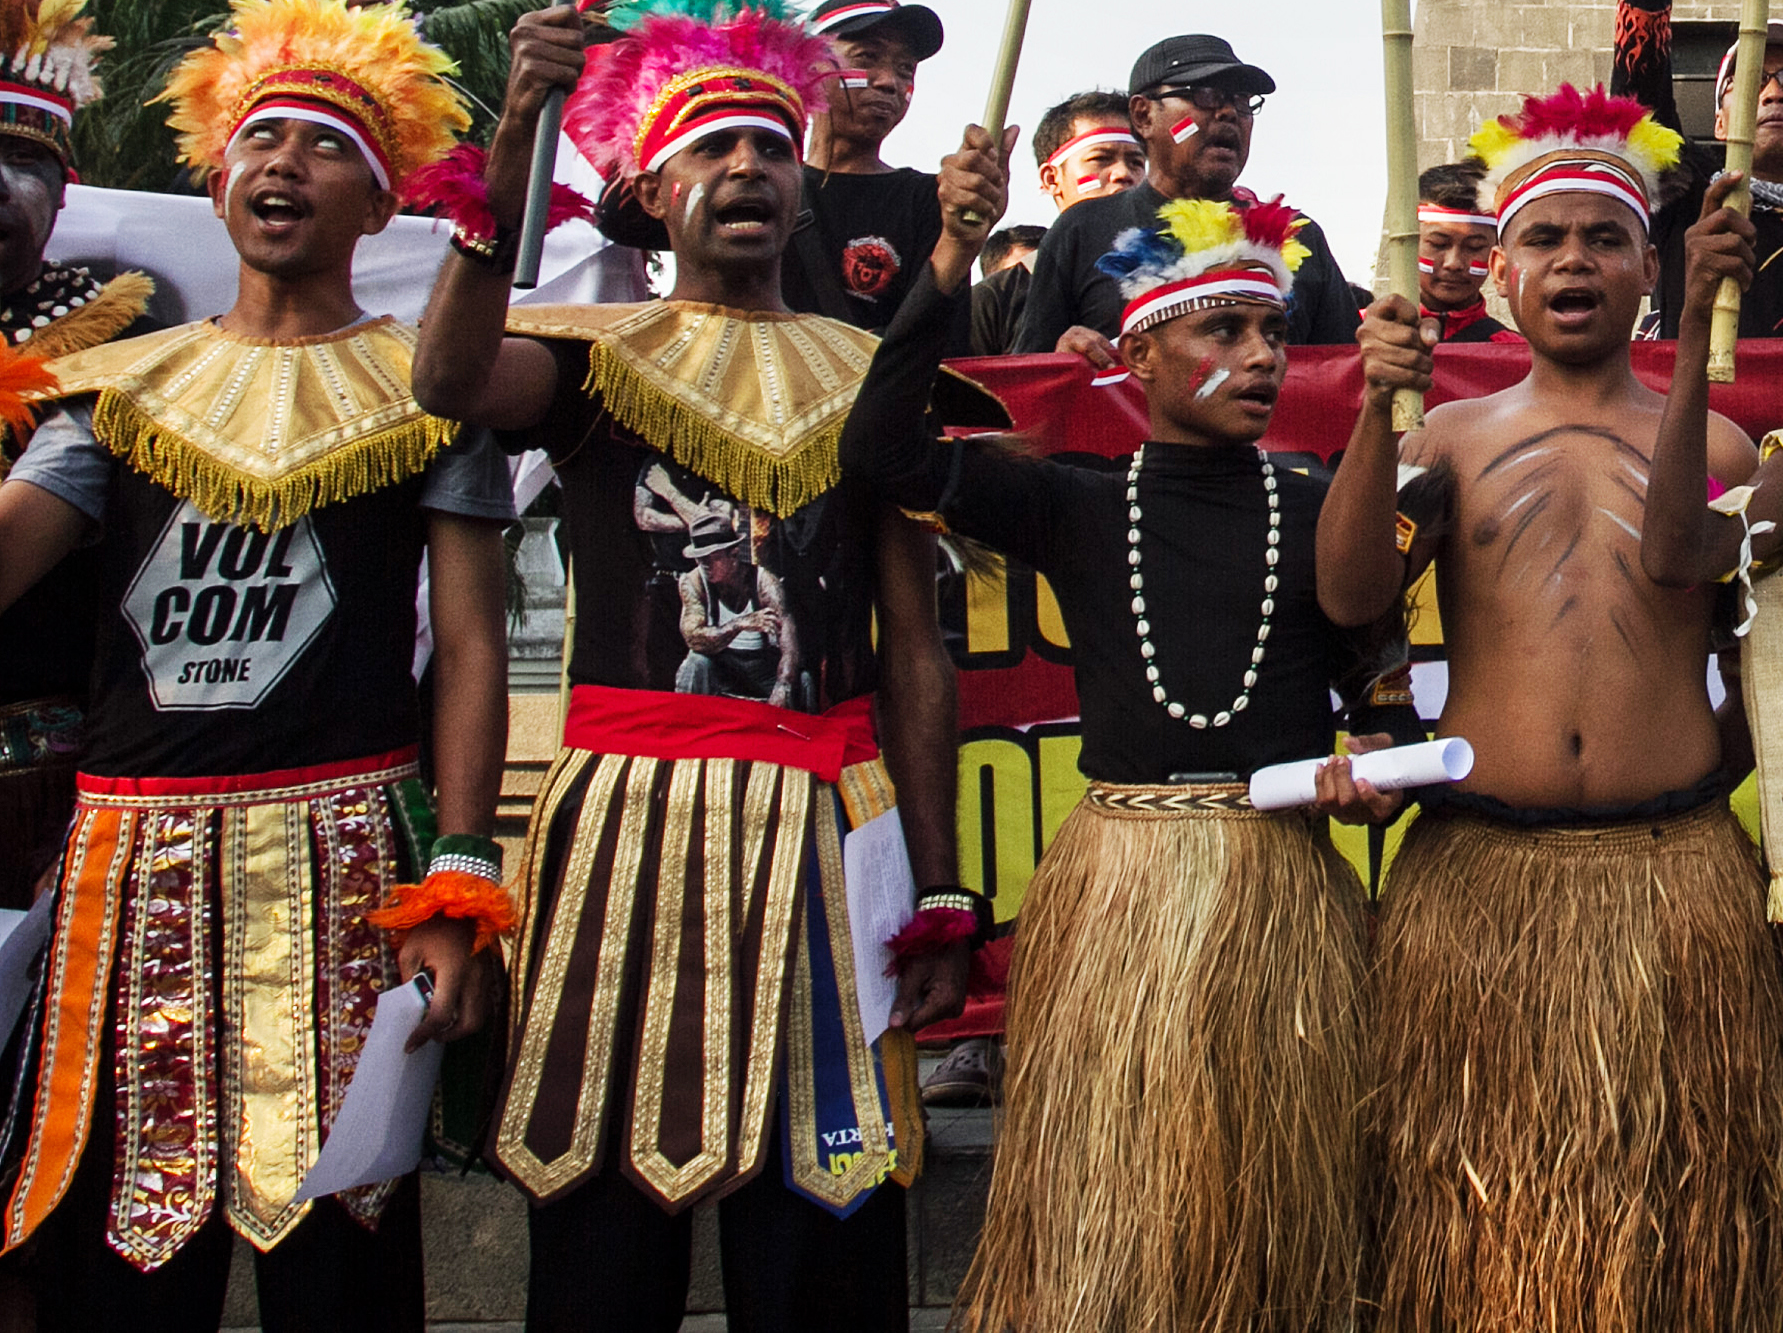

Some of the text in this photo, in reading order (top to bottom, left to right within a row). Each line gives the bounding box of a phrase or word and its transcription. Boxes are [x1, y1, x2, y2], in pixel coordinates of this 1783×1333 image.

[179, 523, 294, 581] VOL
[150, 583, 300, 646] COM
[177, 658, 251, 684] STONE
